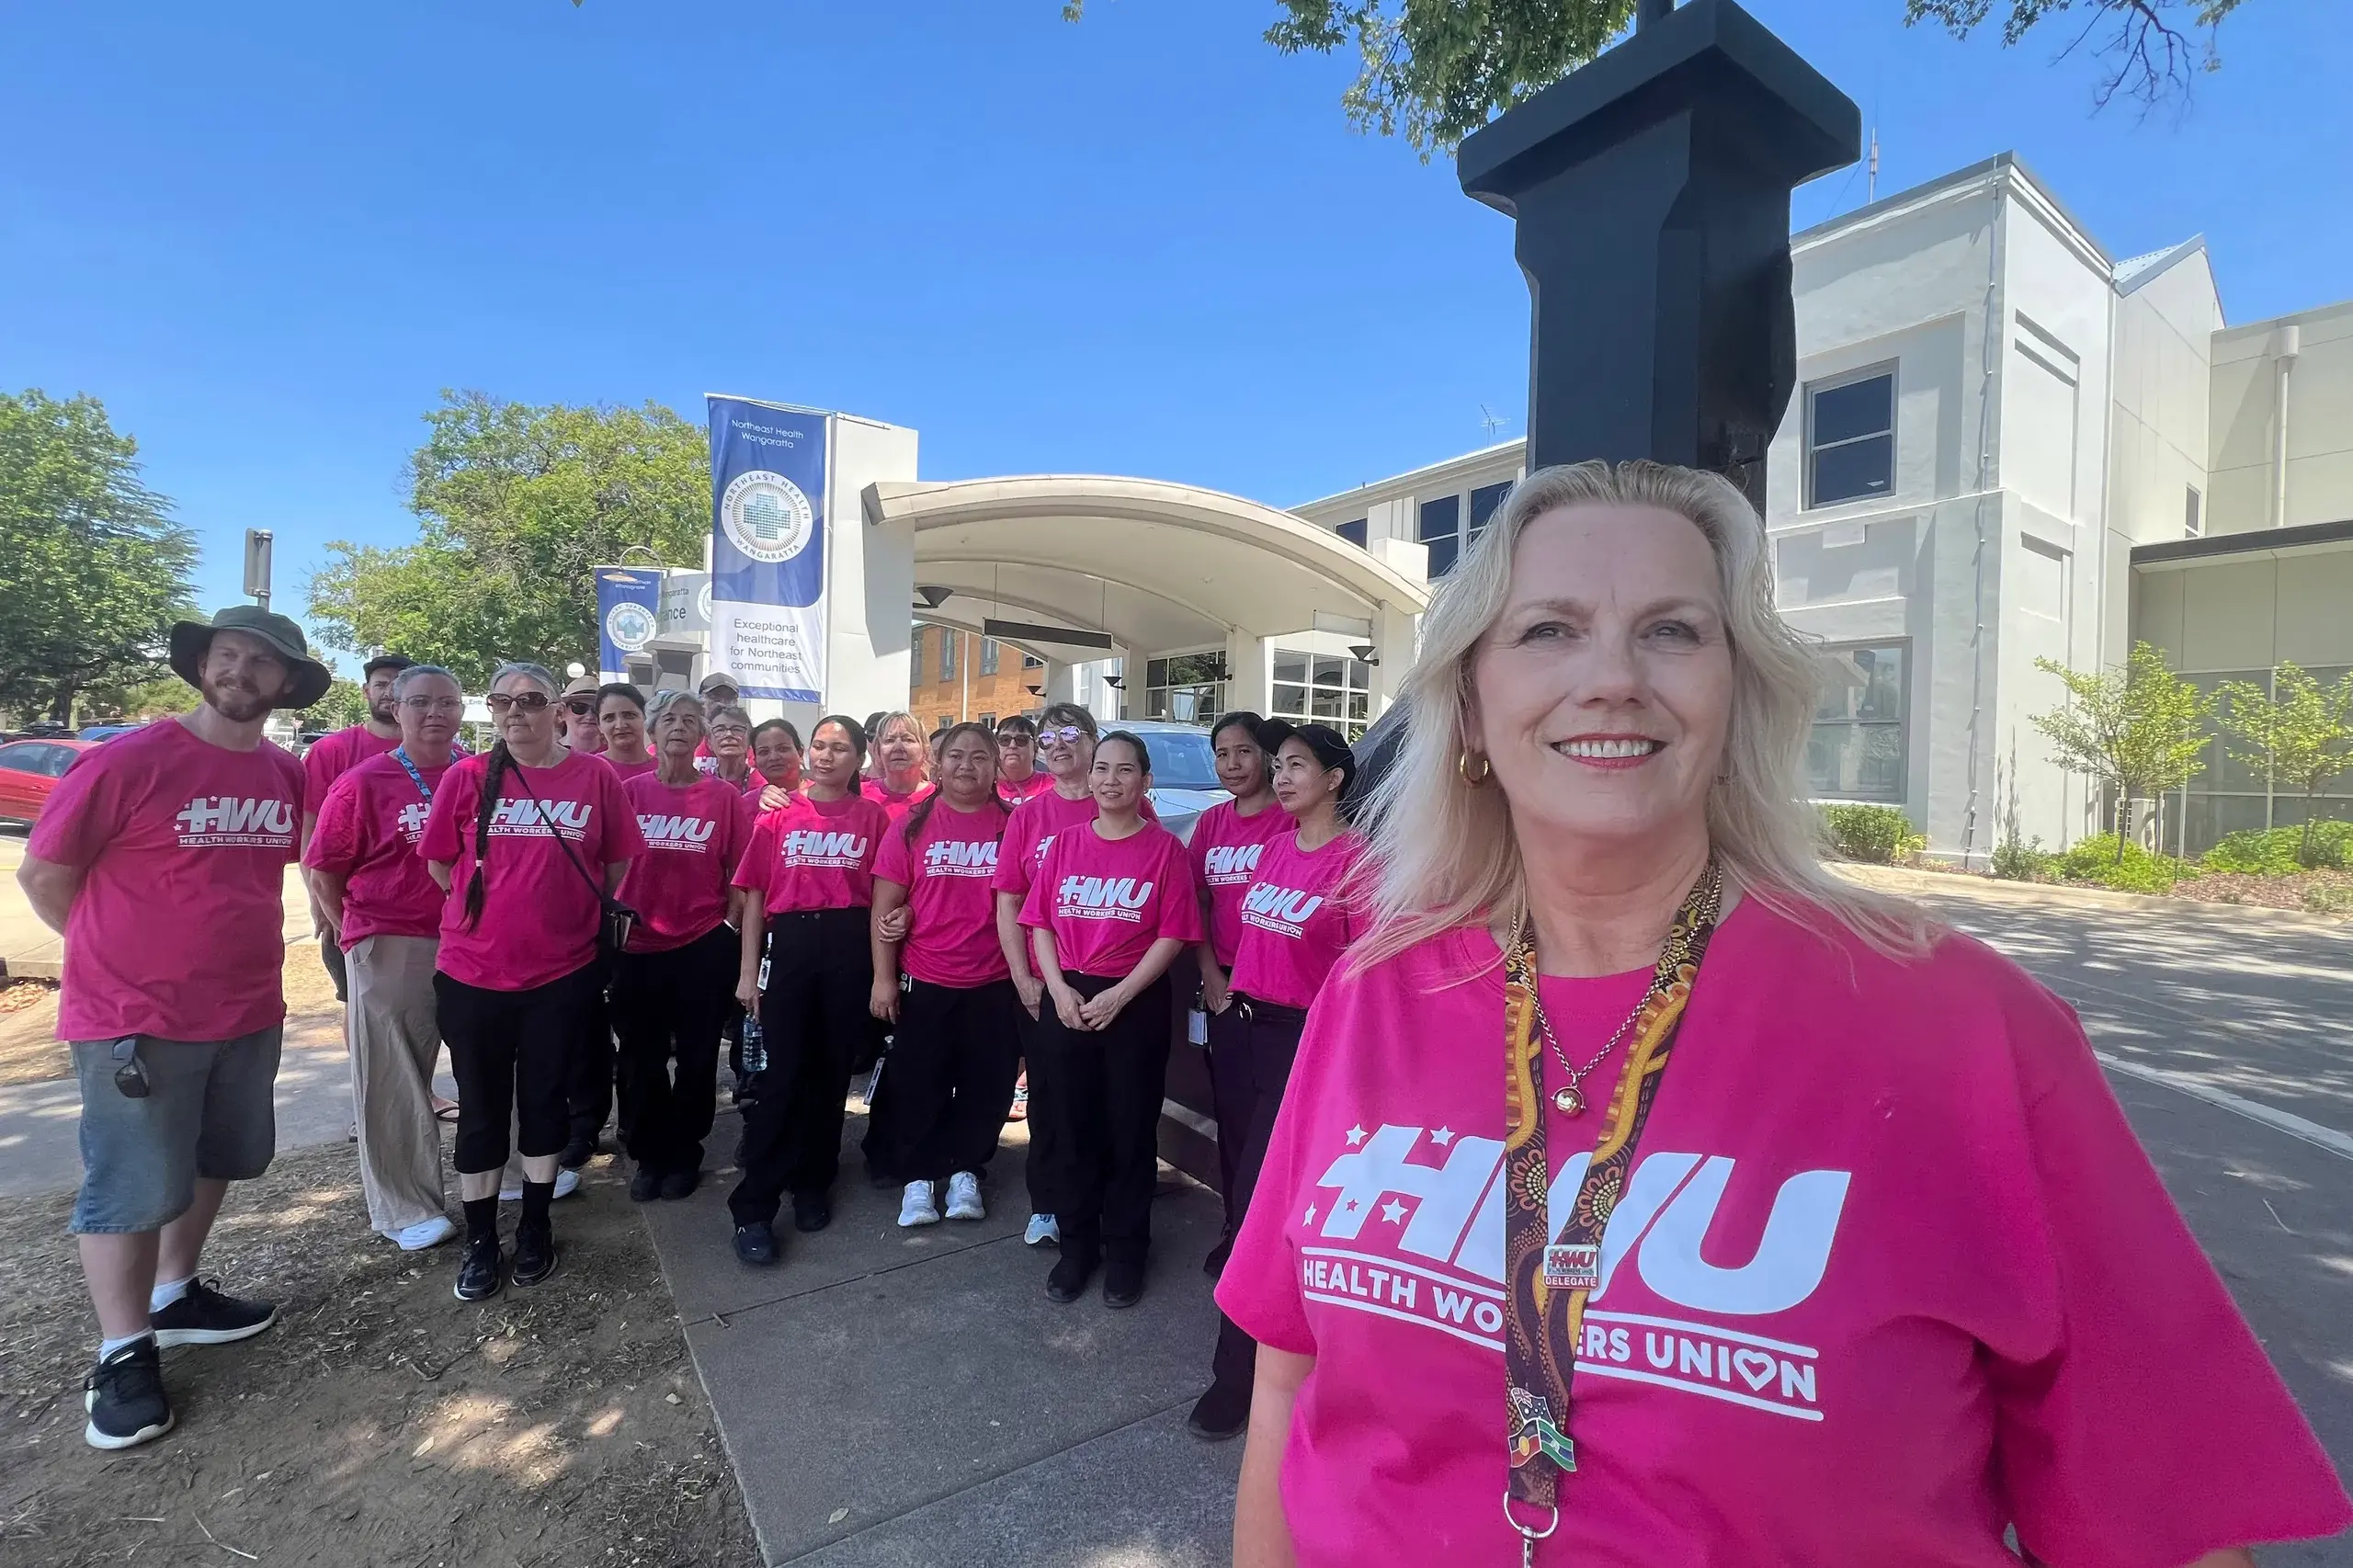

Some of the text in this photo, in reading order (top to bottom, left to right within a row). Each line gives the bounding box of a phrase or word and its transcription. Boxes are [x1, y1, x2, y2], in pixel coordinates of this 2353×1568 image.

[732, 419, 804, 439] Northeast Health
[741, 431, 794, 449] Wangaratta
[724, 473, 810, 519] NORTHEAST HEALTH
[736, 538, 801, 560] WANGARATTA
[733, 618, 799, 633] Exceptional
[736, 632, 796, 646] healthcare
[730, 645, 802, 661] for Northeast
[731, 661, 801, 674] communities
[179, 835, 223, 845] HEALTH
[1117, 911, 1141, 920] UNION
[1303, 1259, 1417, 1309] HEALTH
[1545, 1277, 1597, 1287] DELEGATE
